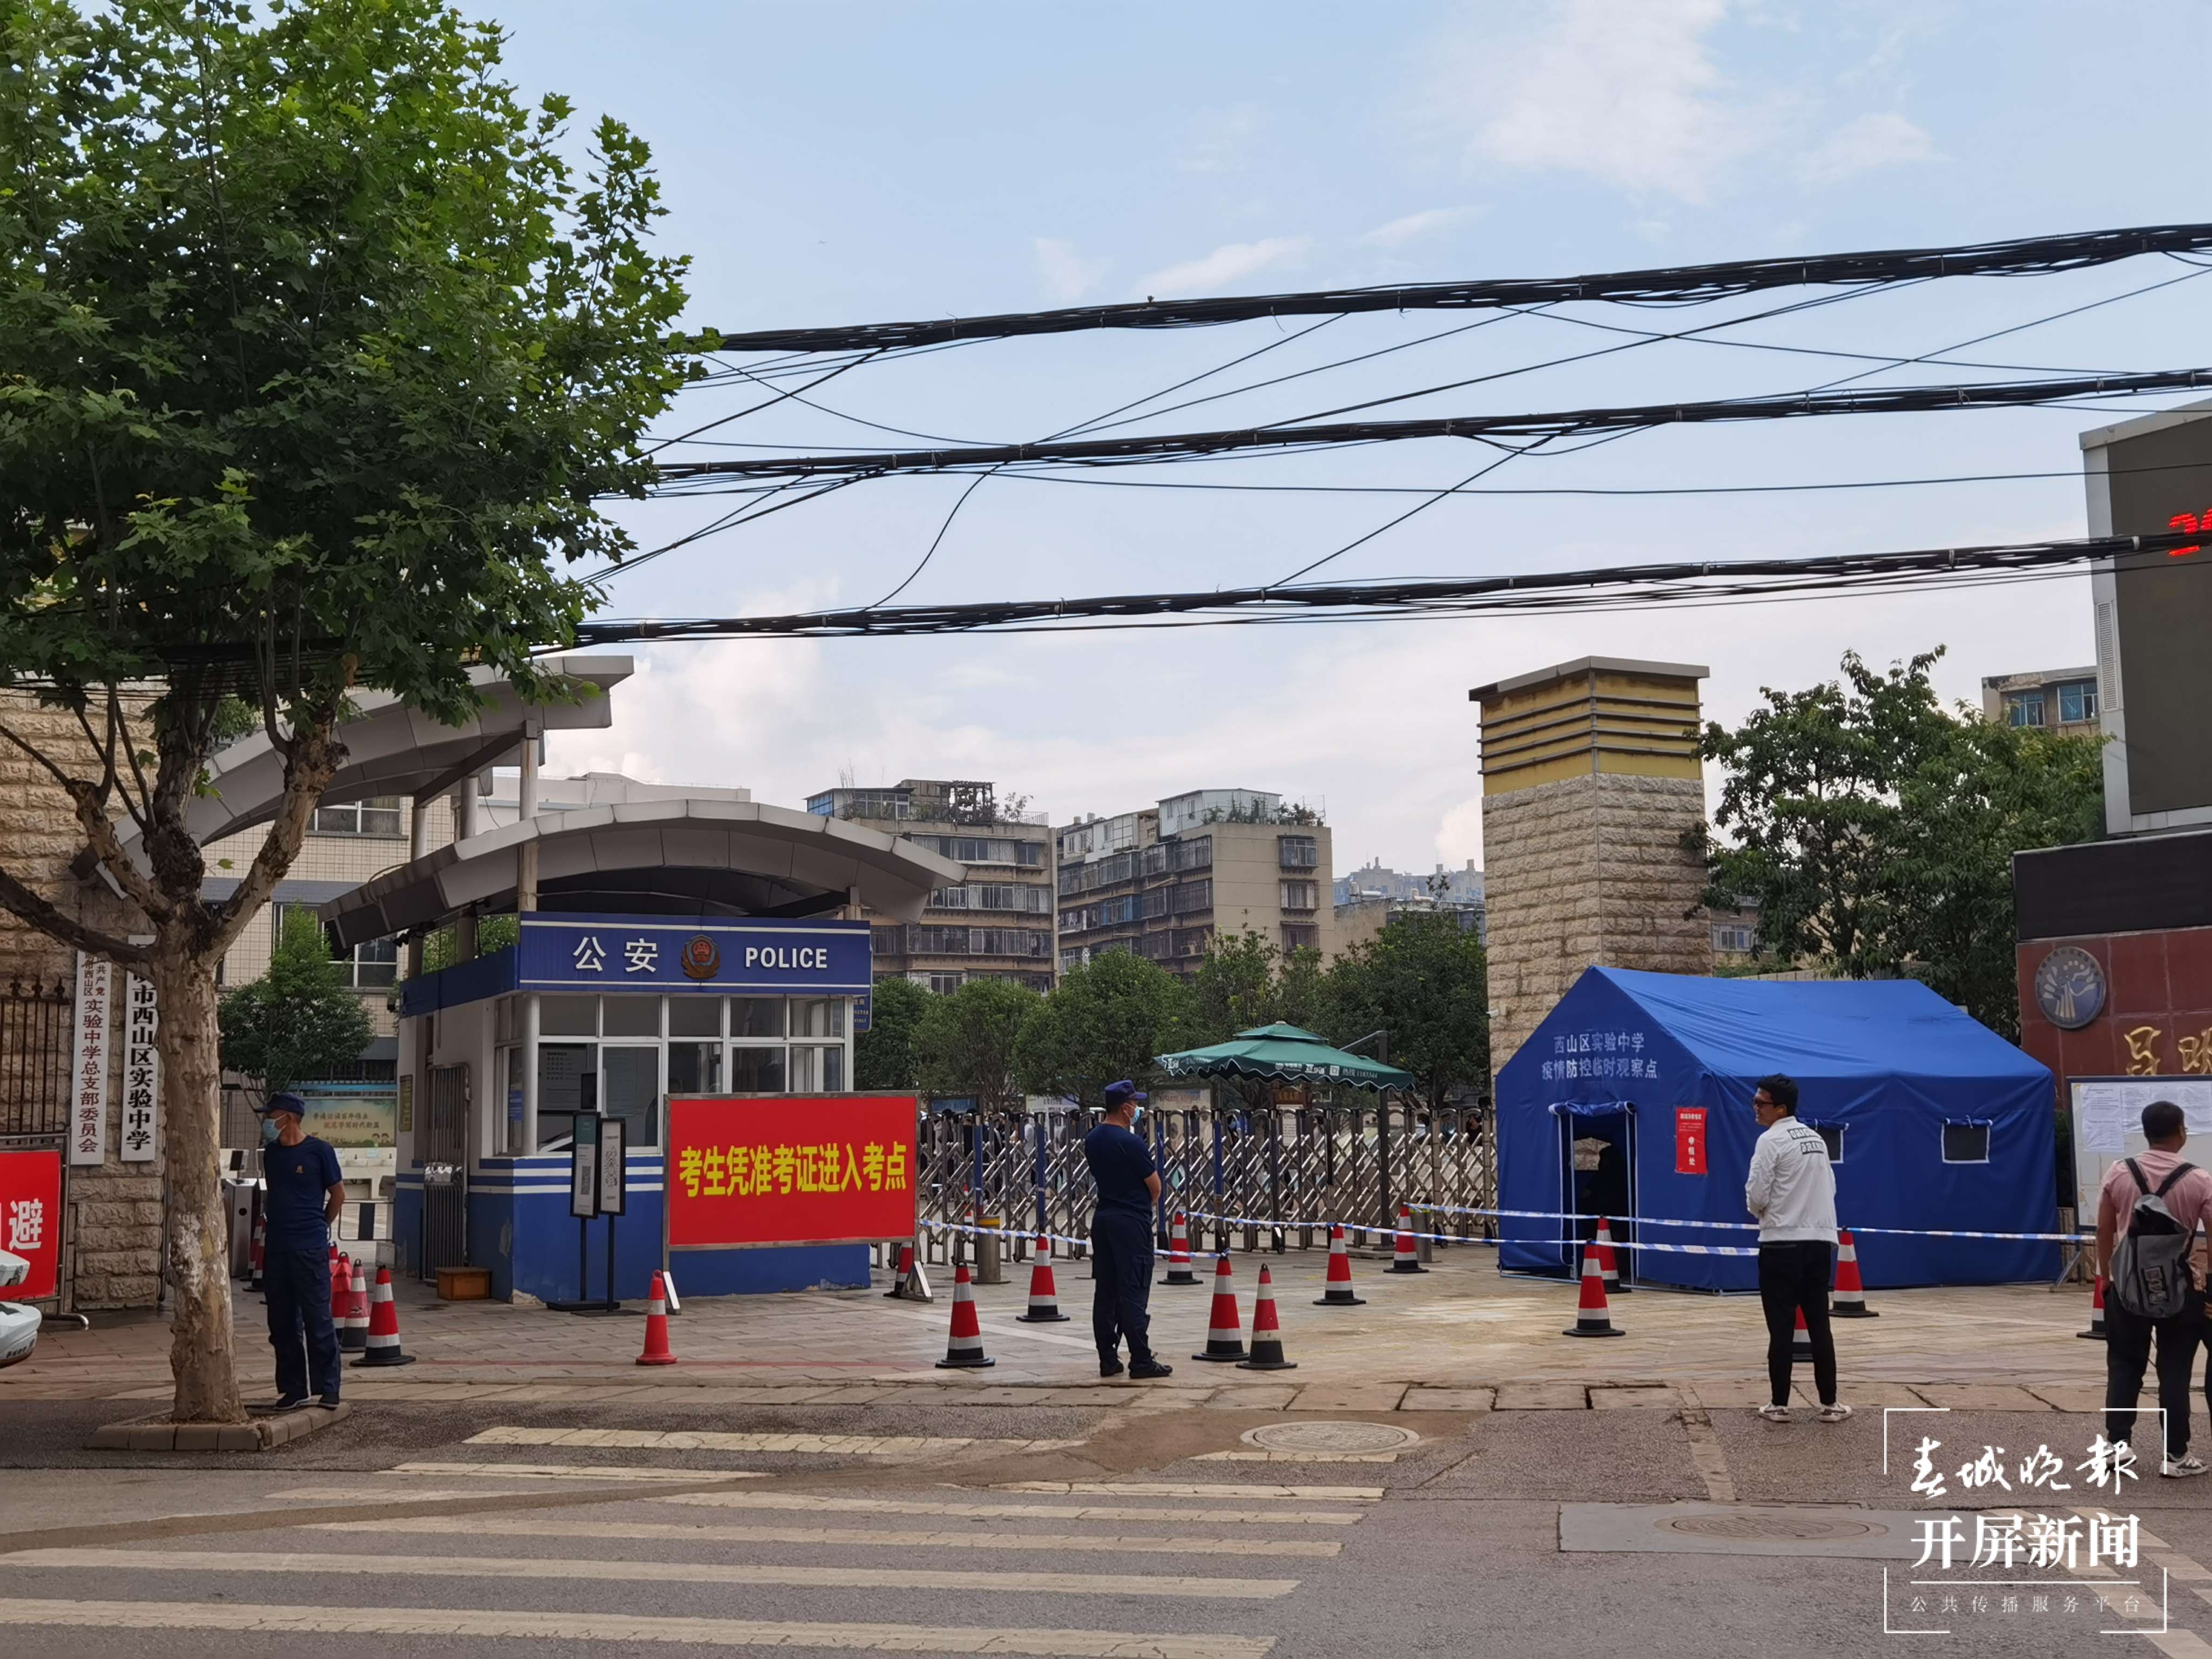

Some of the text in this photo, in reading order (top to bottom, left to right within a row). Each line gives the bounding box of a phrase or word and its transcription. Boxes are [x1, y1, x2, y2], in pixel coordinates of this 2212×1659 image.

[573, 936, 658, 972] 公安
[745, 947, 828, 969] POLICE
[126, 944, 157, 1150] 市西山区实验中学
[1554, 1031, 1645, 1055] 西山区实验中学
[78, 999, 104, 1153] 实验中学总支部委员会
[1541, 1056, 1658, 1080] 疫情防控临时观察点
[679, 1141, 907, 1197] 考生凭准考证进入考点
[0, 1198, 43, 1251] 避
